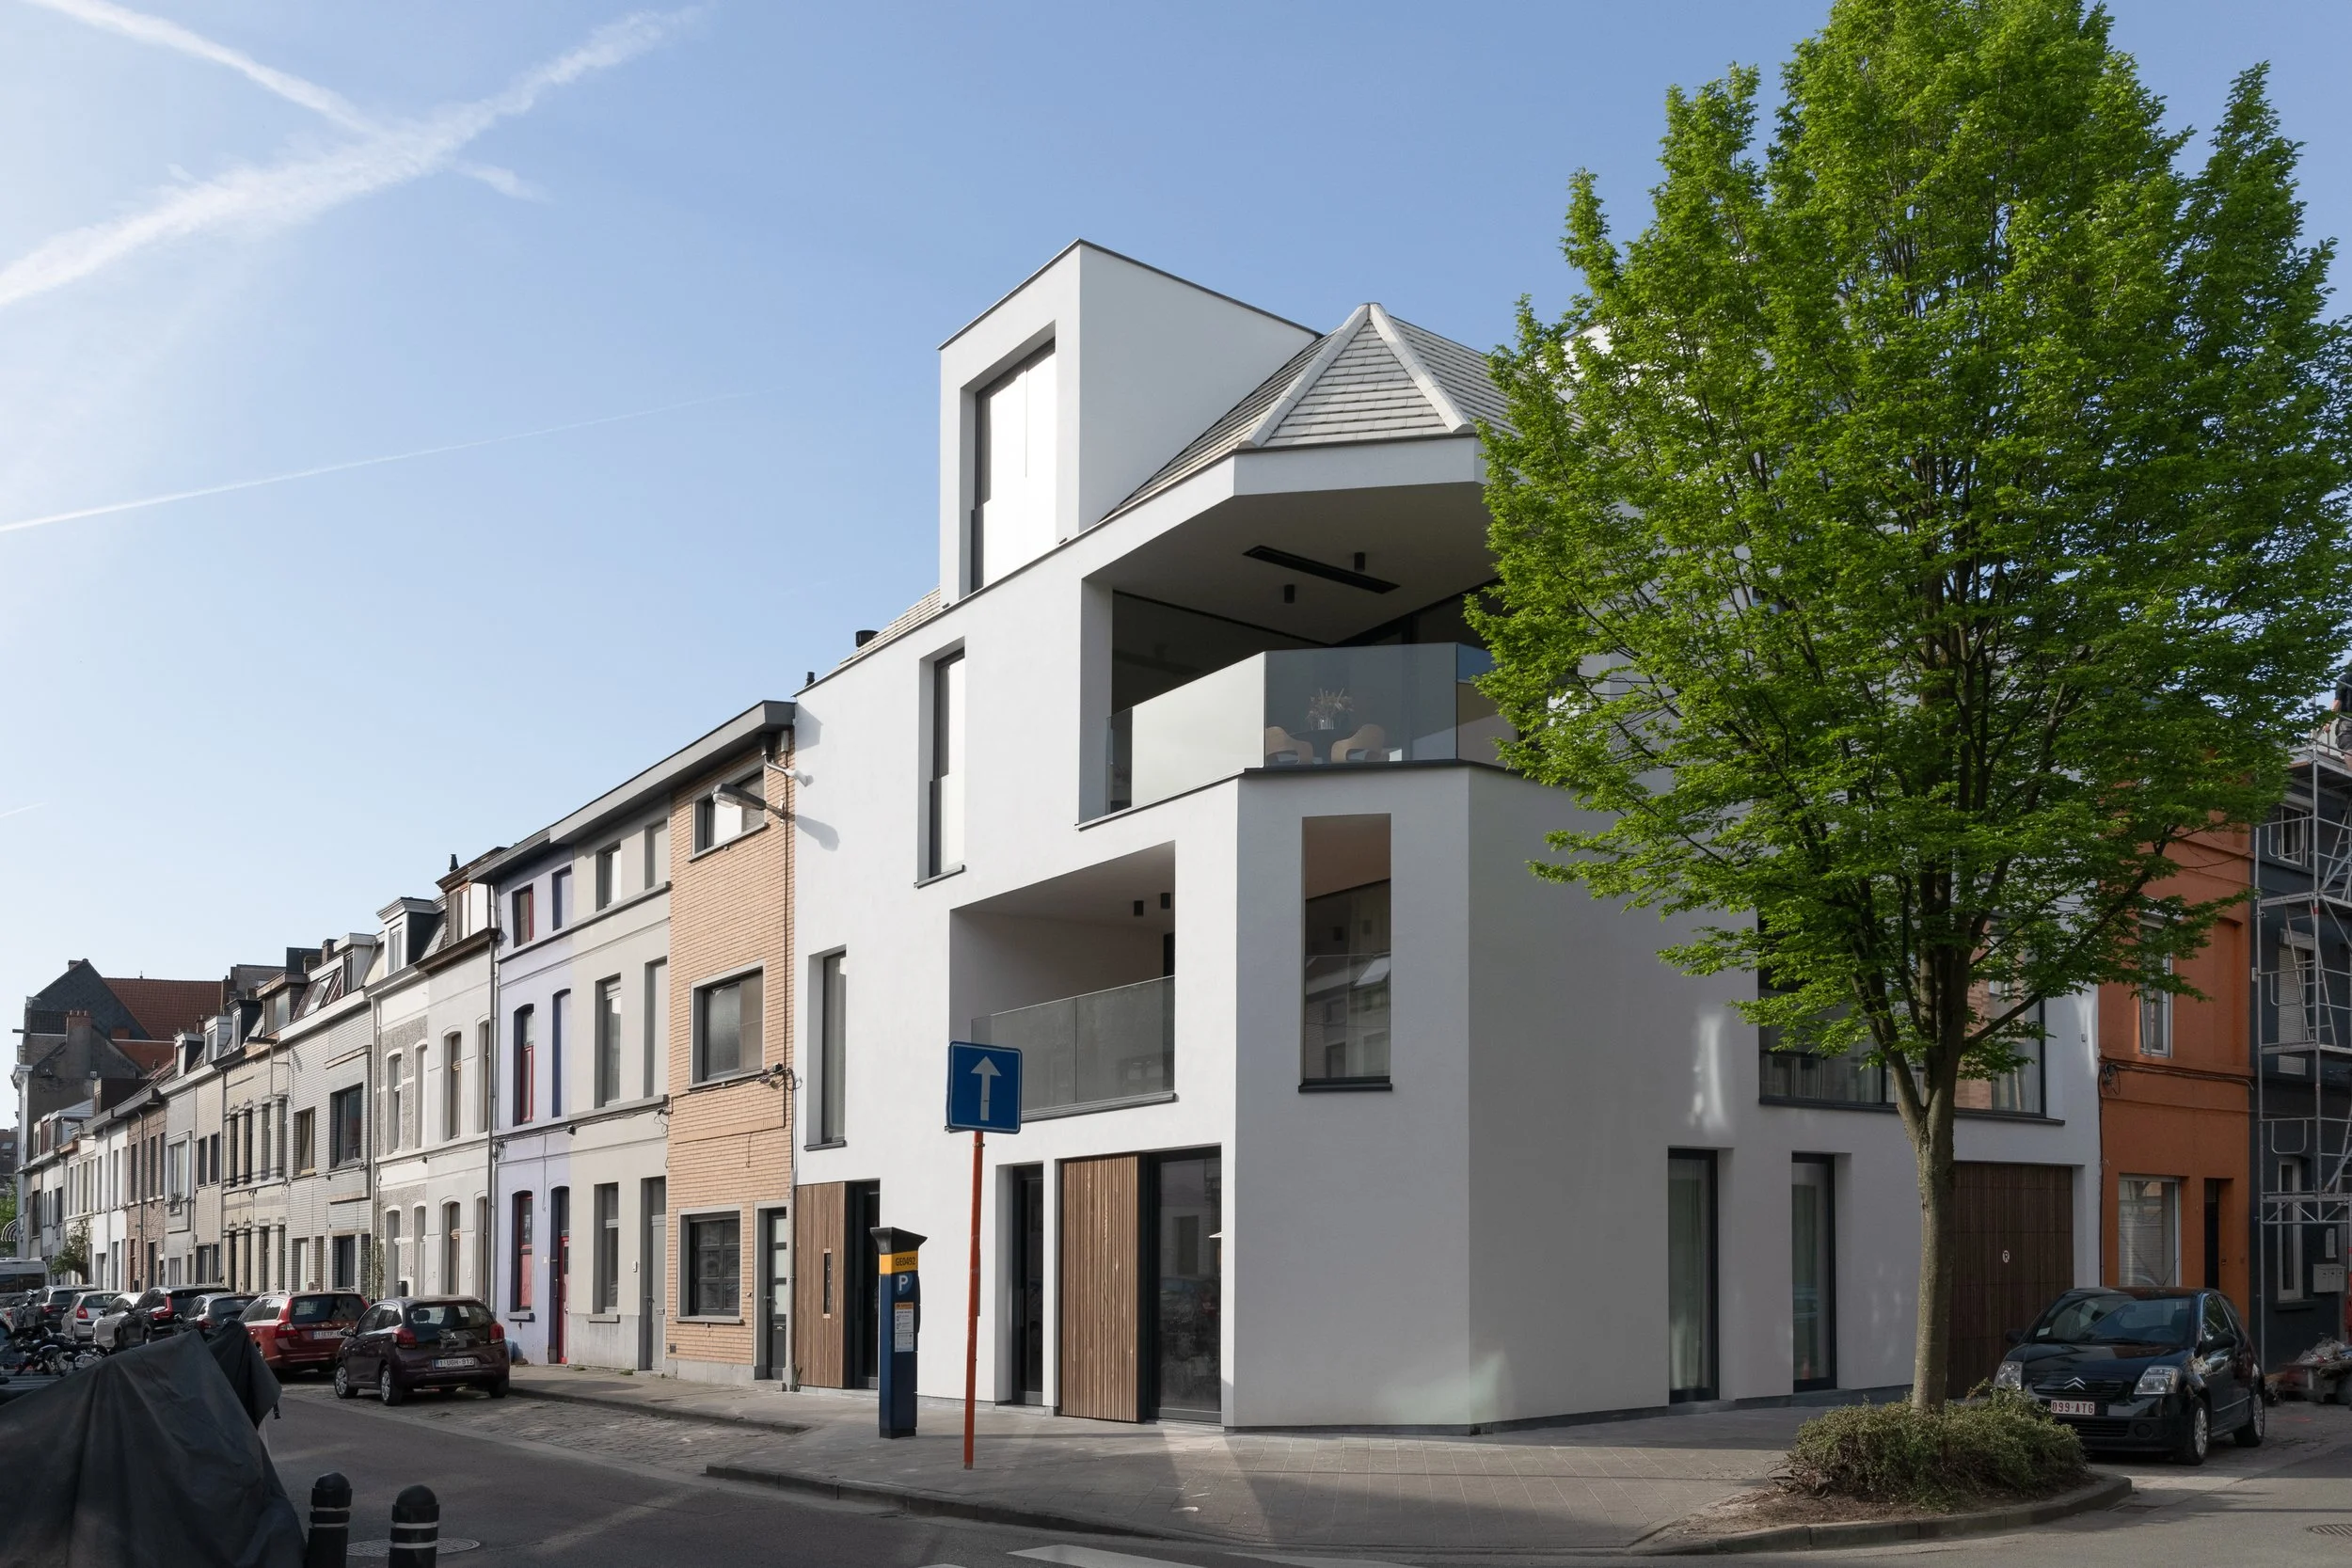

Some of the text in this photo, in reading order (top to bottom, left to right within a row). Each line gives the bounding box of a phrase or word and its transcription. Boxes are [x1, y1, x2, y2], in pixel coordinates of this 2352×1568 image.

[895, 1257, 916, 1266] GE0492
[898, 1275, 909, 1291] P
[2052, 1402, 2093, 1414] 099-ATG
